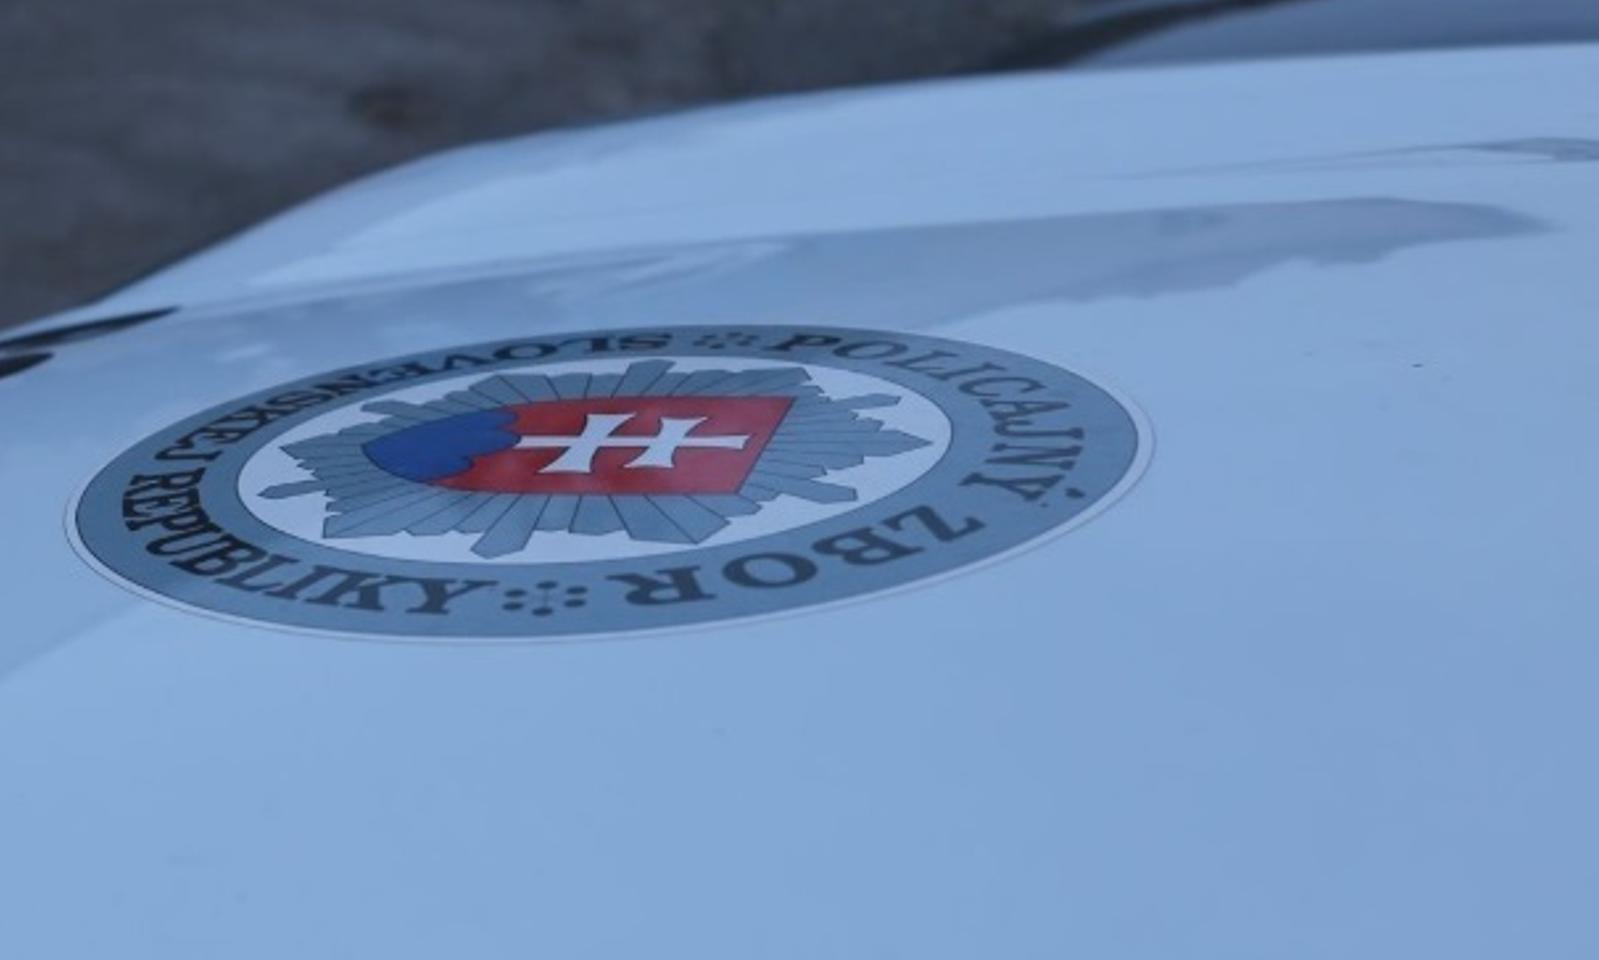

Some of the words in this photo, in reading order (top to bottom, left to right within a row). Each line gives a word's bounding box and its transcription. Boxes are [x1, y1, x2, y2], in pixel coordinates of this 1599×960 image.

[762, 331, 1086, 508] POLICAJNÝ
[121, 467, 499, 616] REPUBLIKY
[605, 505, 988, 607] ZBOR
